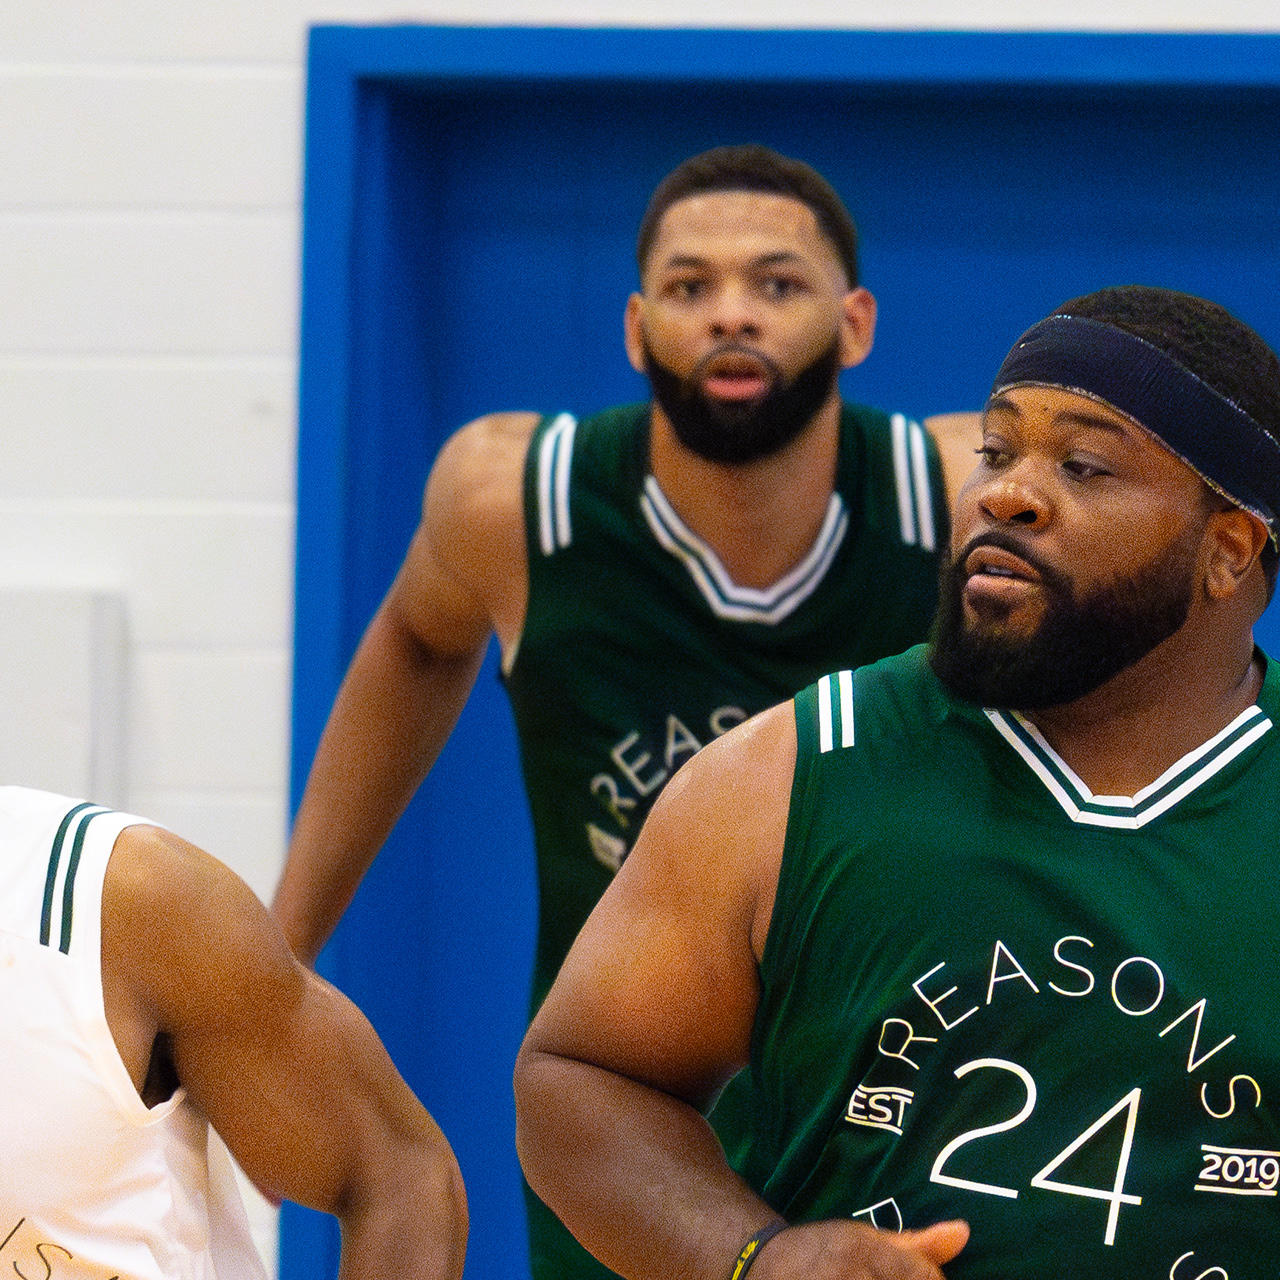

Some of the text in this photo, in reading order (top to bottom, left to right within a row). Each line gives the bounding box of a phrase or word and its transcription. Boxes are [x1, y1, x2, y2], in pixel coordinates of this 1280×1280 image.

[588, 705, 750, 829] REAS
[878, 935, 1262, 1119] REASONS
[848, 1088, 913, 1128] EST
[929, 1057, 1143, 1246] 24
[1198, 1152, 1280, 1190] 2019
